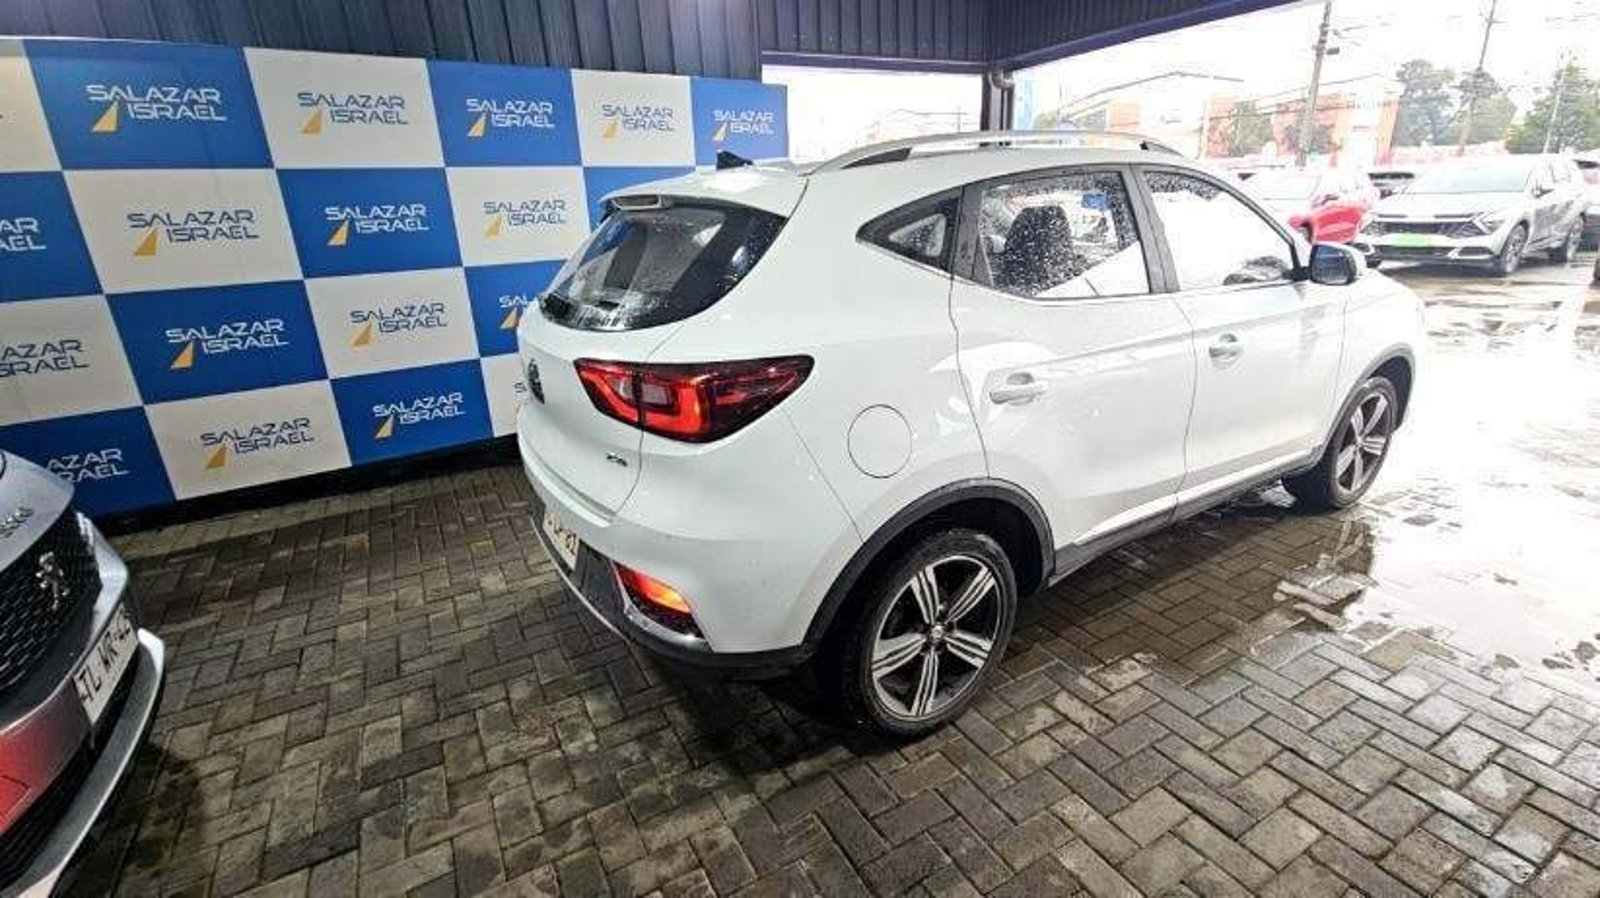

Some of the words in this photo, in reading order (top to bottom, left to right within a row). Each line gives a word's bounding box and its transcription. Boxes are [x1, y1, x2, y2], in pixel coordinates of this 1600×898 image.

[86, 84, 222, 105] SALAZAR
[297, 91, 406, 110] SALAZAR
[126, 101, 228, 122] ISRAEL
[465, 98, 554, 114] SALAZAR
[601, 103, 674, 119] SALAZAR
[328, 107, 410, 126] ISRAEL
[491, 113, 556, 129] ISRAEL
[622, 117, 675, 132] ISRAEL
[324, 202, 427, 222] SALAZAR
[482, 198, 566, 215] SALAZAR
[126, 208, 255, 229] SALAZAR
[355, 217, 430, 234] ISRAEL
[506, 212, 567, 227] ISRAEL
[166, 224, 260, 243] ISRAEL
[350, 302, 446, 324] SALAZAR
[165, 318, 286, 344] SALAZAR
[377, 316, 448, 334] ISRAEL
[201, 333, 289, 355] ISRAEL
[373, 391, 465, 418] SALAZAR
[398, 405, 466, 425] ISRAEL
[200, 416, 311, 447] SALAZAR
[233, 429, 315, 454] ISRAEL
